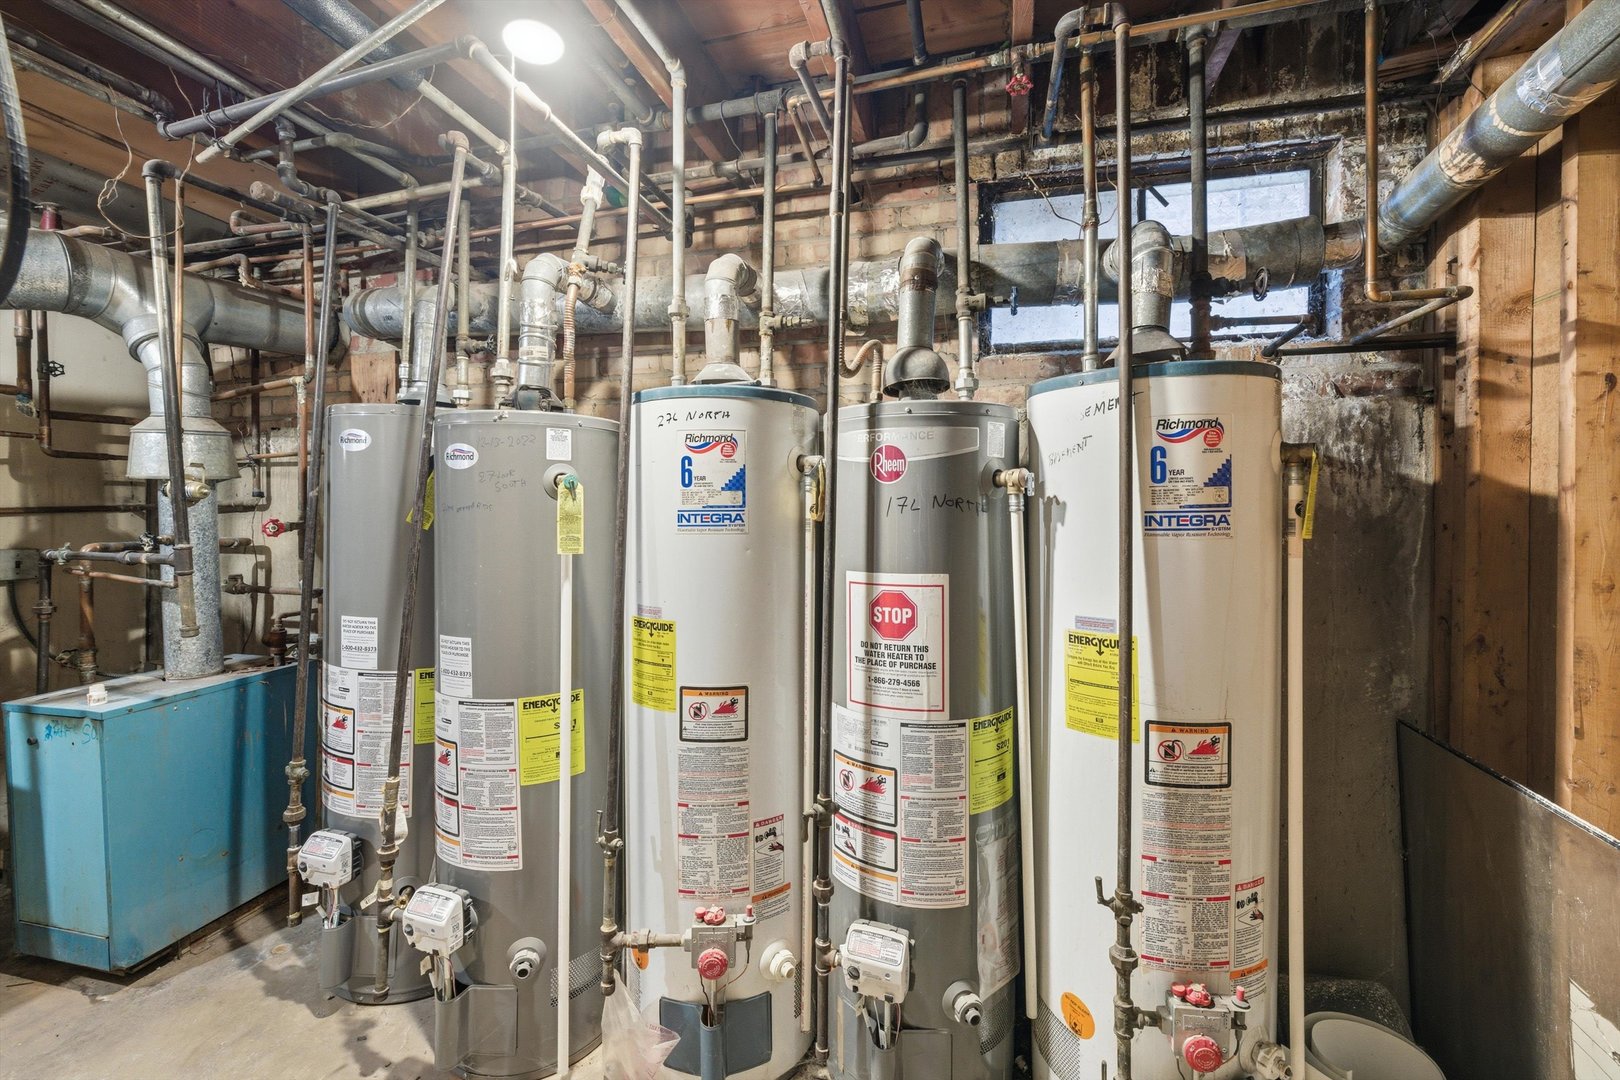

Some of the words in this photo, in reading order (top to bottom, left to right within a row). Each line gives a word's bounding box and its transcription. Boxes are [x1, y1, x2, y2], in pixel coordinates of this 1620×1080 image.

[685, 410, 731, 422] NORTH
[1156, 417, 1219, 430] Richmond
[340, 436, 368, 444] Richmond
[684, 433, 734, 443] Richmond
[446, 451, 475, 461] Richmond
[874, 445, 905, 478] Rheem
[681, 455, 693, 488] 6
[1150, 445, 1167, 485] 6
[677, 513, 745, 523] INTEGRA
[1144, 514, 1231, 527] INTEGRA
[873, 606, 913, 624] STOP
[633, 619, 674, 633] ENERGYGUIDE
[860, 640, 869, 649] DO
[869, 641, 882, 650] NOT
[884, 643, 911, 653] RETURN
[913, 645, 929, 653] THIS
[864, 650, 886, 660] WATER
[886, 652, 913, 661] HEATER
[915, 653, 925, 662] TO
[854, 656, 866, 665] THE
[866, 657, 886, 668] PLACE
[888, 660, 898, 668] OF
[899, 661, 937, 670] PURCHASE
[973, 710, 1012, 731] ENERGYGUIDE
